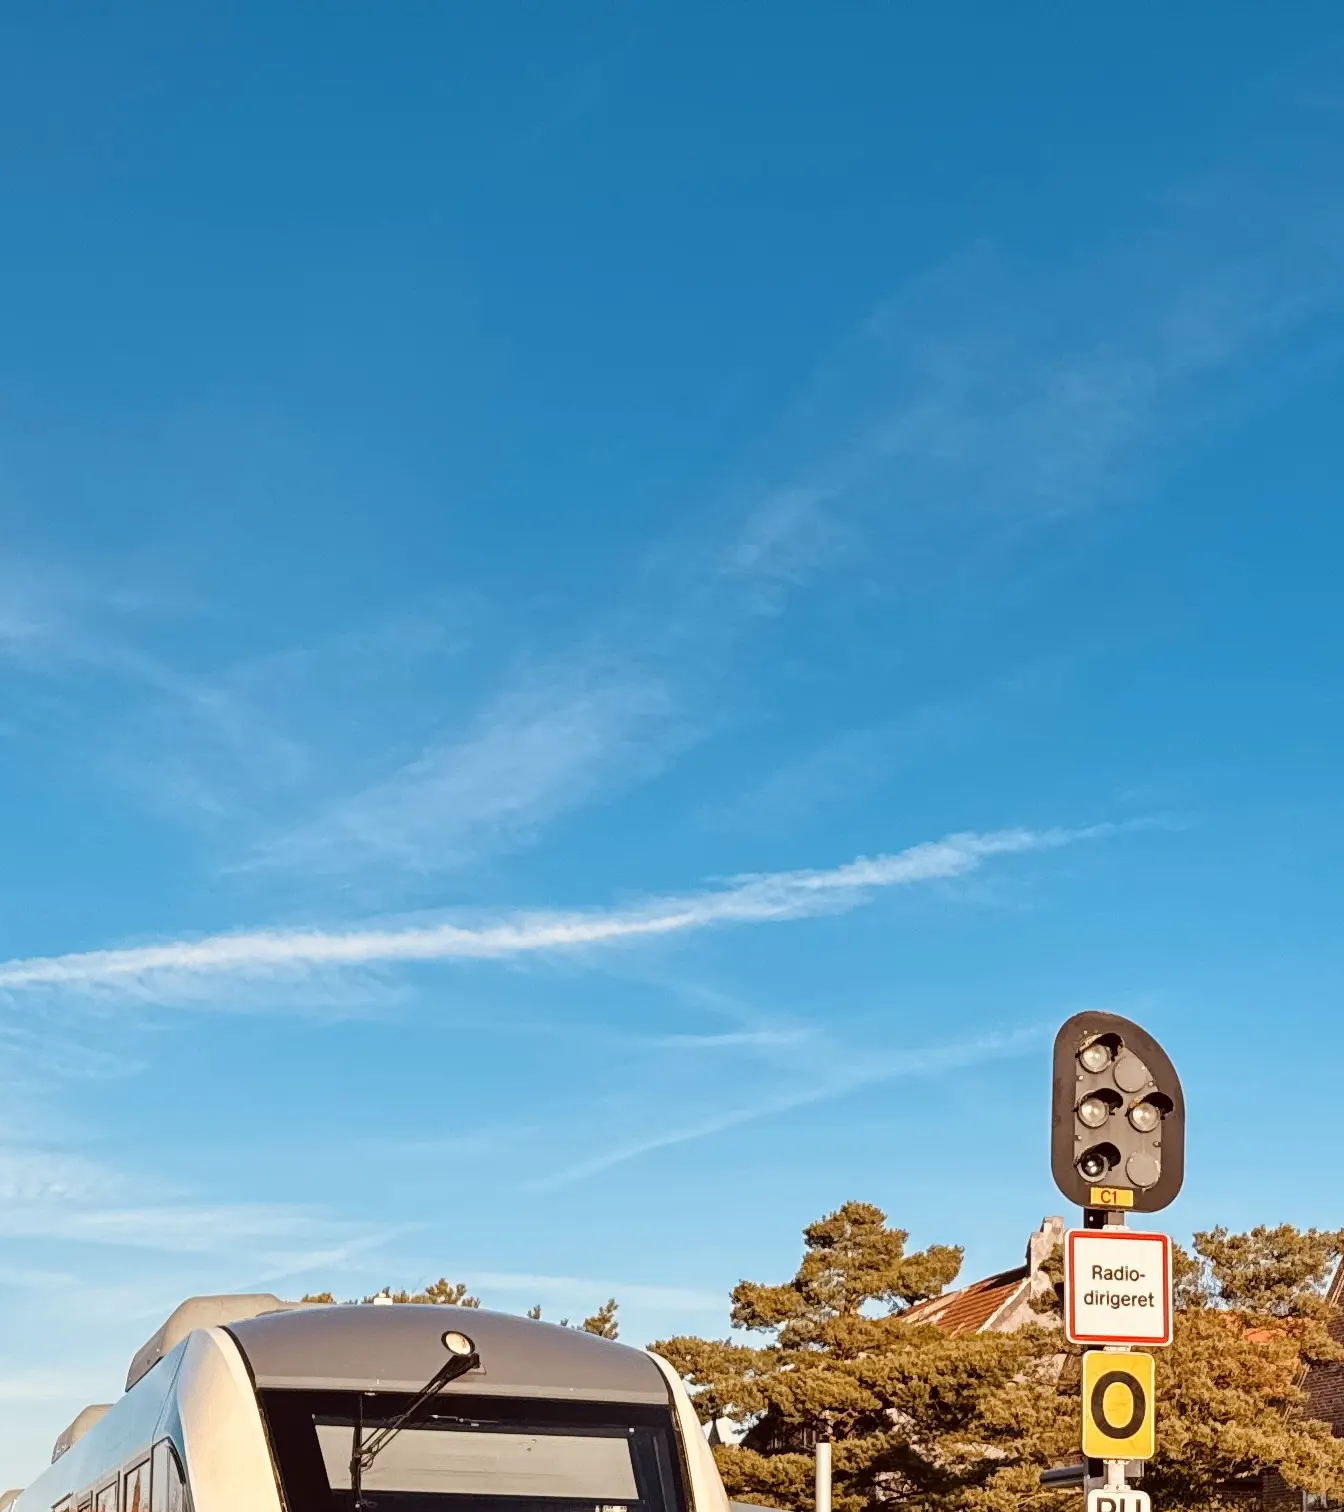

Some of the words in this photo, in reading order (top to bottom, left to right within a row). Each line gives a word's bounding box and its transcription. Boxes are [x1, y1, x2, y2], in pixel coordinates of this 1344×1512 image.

[1100, 1190, 1118, 1205] C1
[1091, 1264, 1146, 1282] Radio-
[1083, 1289, 1155, 1310] dirigeret
